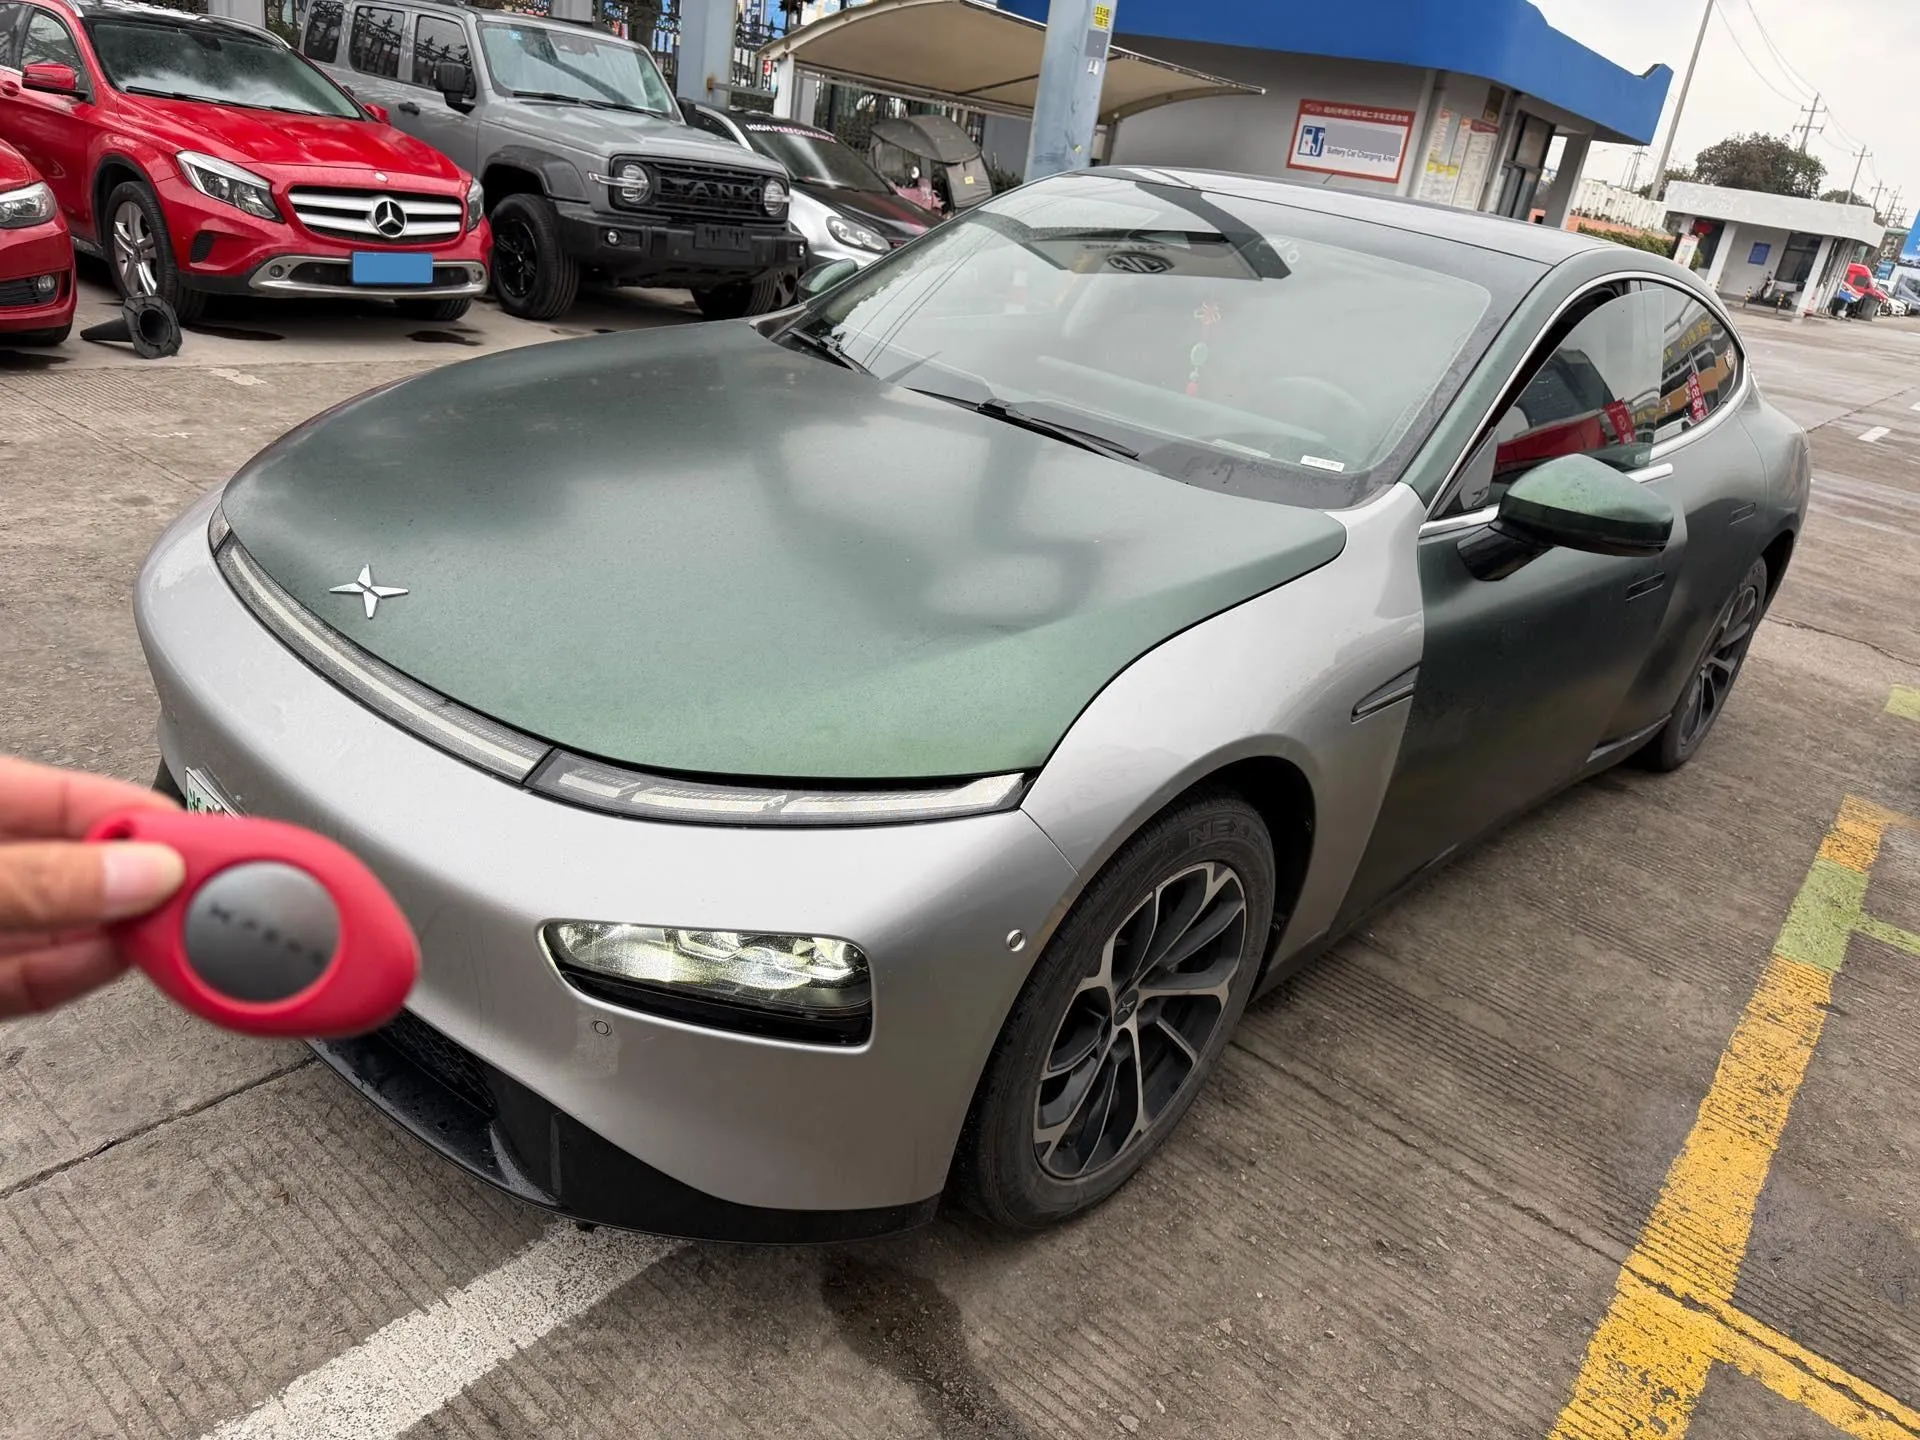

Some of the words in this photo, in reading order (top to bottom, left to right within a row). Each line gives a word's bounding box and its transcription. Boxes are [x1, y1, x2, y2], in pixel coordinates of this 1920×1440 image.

[746, 124, 772, 132] HIGH
[1327, 147, 1345, 157] Battery
[1346, 150, 1356, 158] Car
[1357, 151, 1382, 161] Charging
[1383, 154, 1396, 162] Area
[658, 177, 761, 203] TANK
